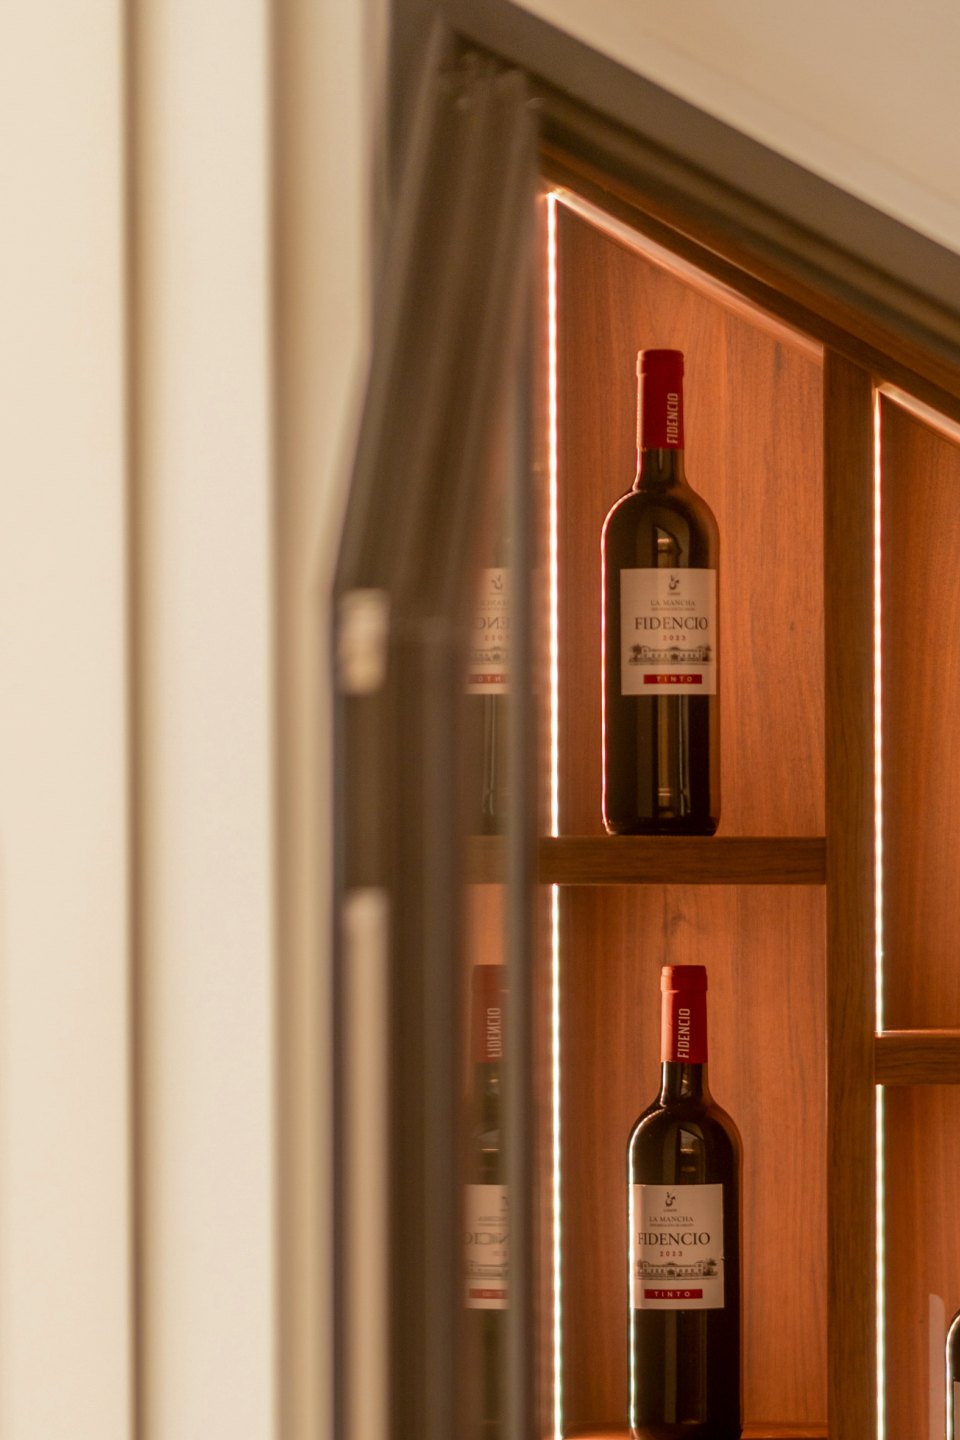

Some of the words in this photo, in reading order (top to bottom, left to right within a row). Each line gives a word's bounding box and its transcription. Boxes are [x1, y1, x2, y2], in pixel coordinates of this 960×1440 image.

[666, 392, 679, 444] FIDENCIO
[634, 616, 709, 630] FIDENCIO
[677, 1008, 691, 1059] FIDENCIO
[638, 1231, 711, 1246] FIDENCIO
